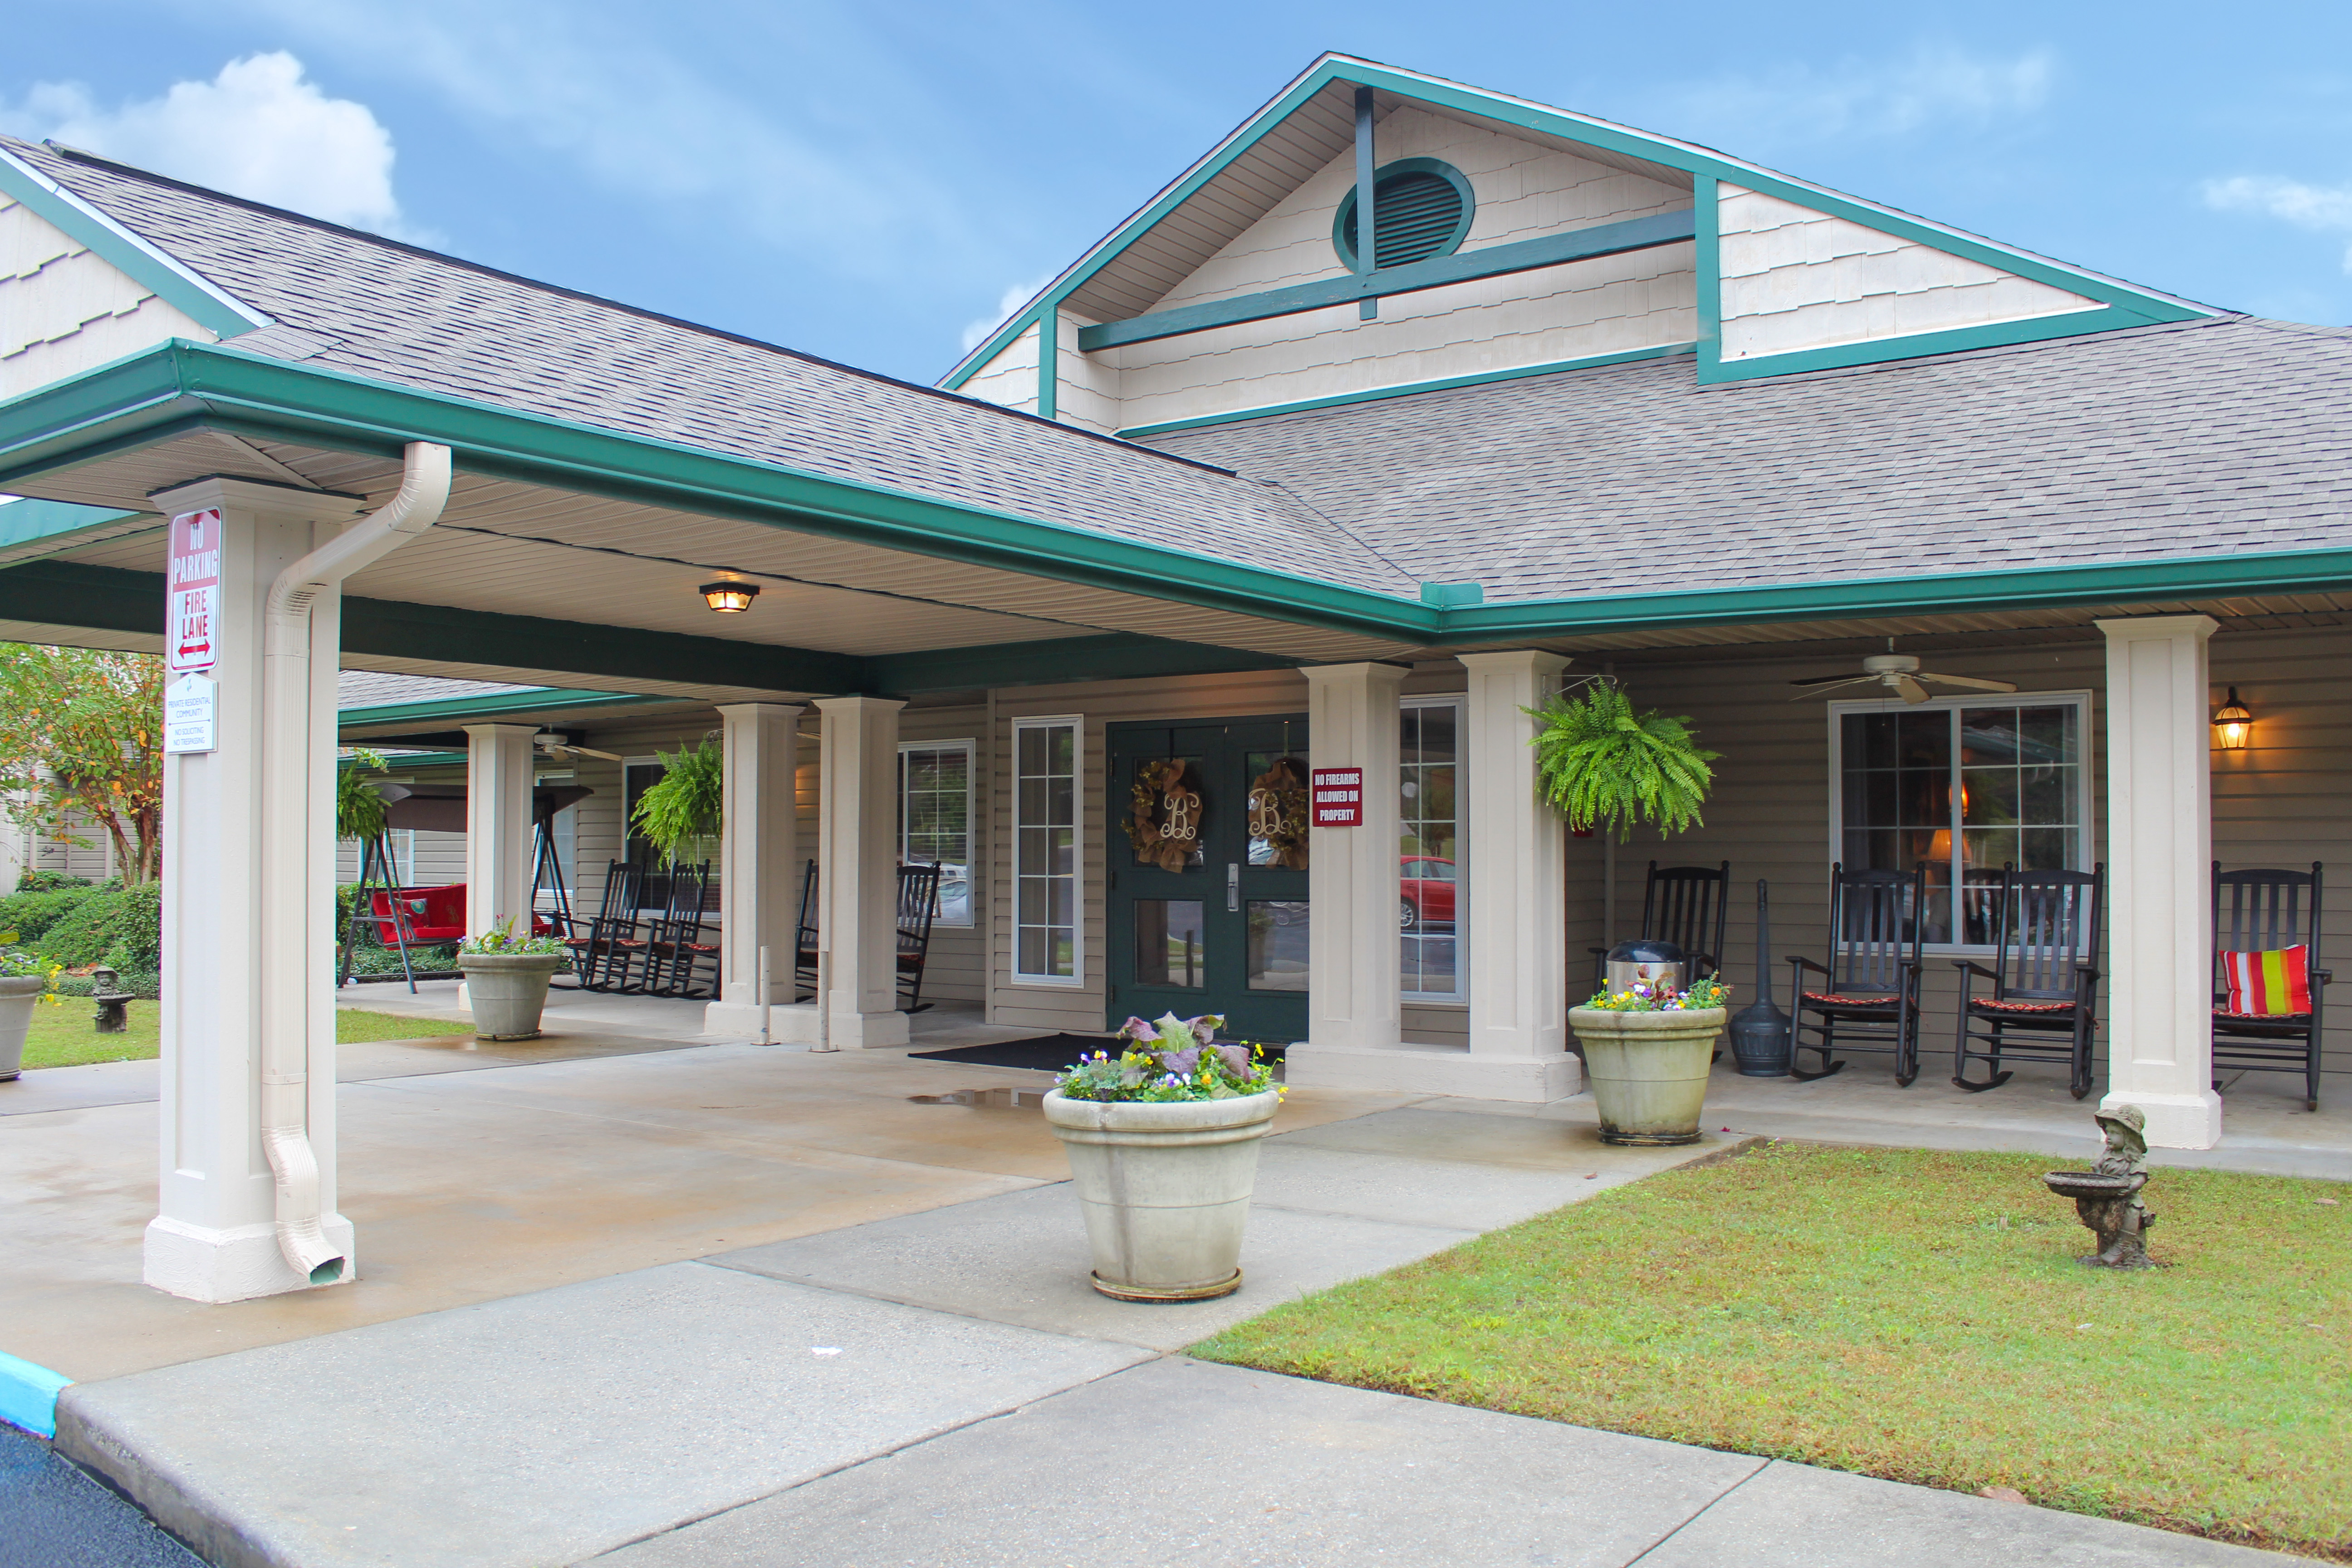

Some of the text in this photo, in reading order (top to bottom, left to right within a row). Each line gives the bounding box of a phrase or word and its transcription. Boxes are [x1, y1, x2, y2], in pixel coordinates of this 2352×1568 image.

[190, 522, 203, 550] NO
[174, 549, 217, 584] PARKING
[185, 591, 206, 615] FIRE
[183, 615, 208, 639] LANE
[168, 697, 211, 708] PRIVATE RESIDENTIAL
[176, 708, 203, 718] COMMUNITY
[181, 737, 205, 745] TRESPASSING
[1315, 773, 1360, 786] NO FIREARMS
[1316, 790, 1359, 803] ALLOWED ON
[1319, 808, 1355, 821] PROPERTY
